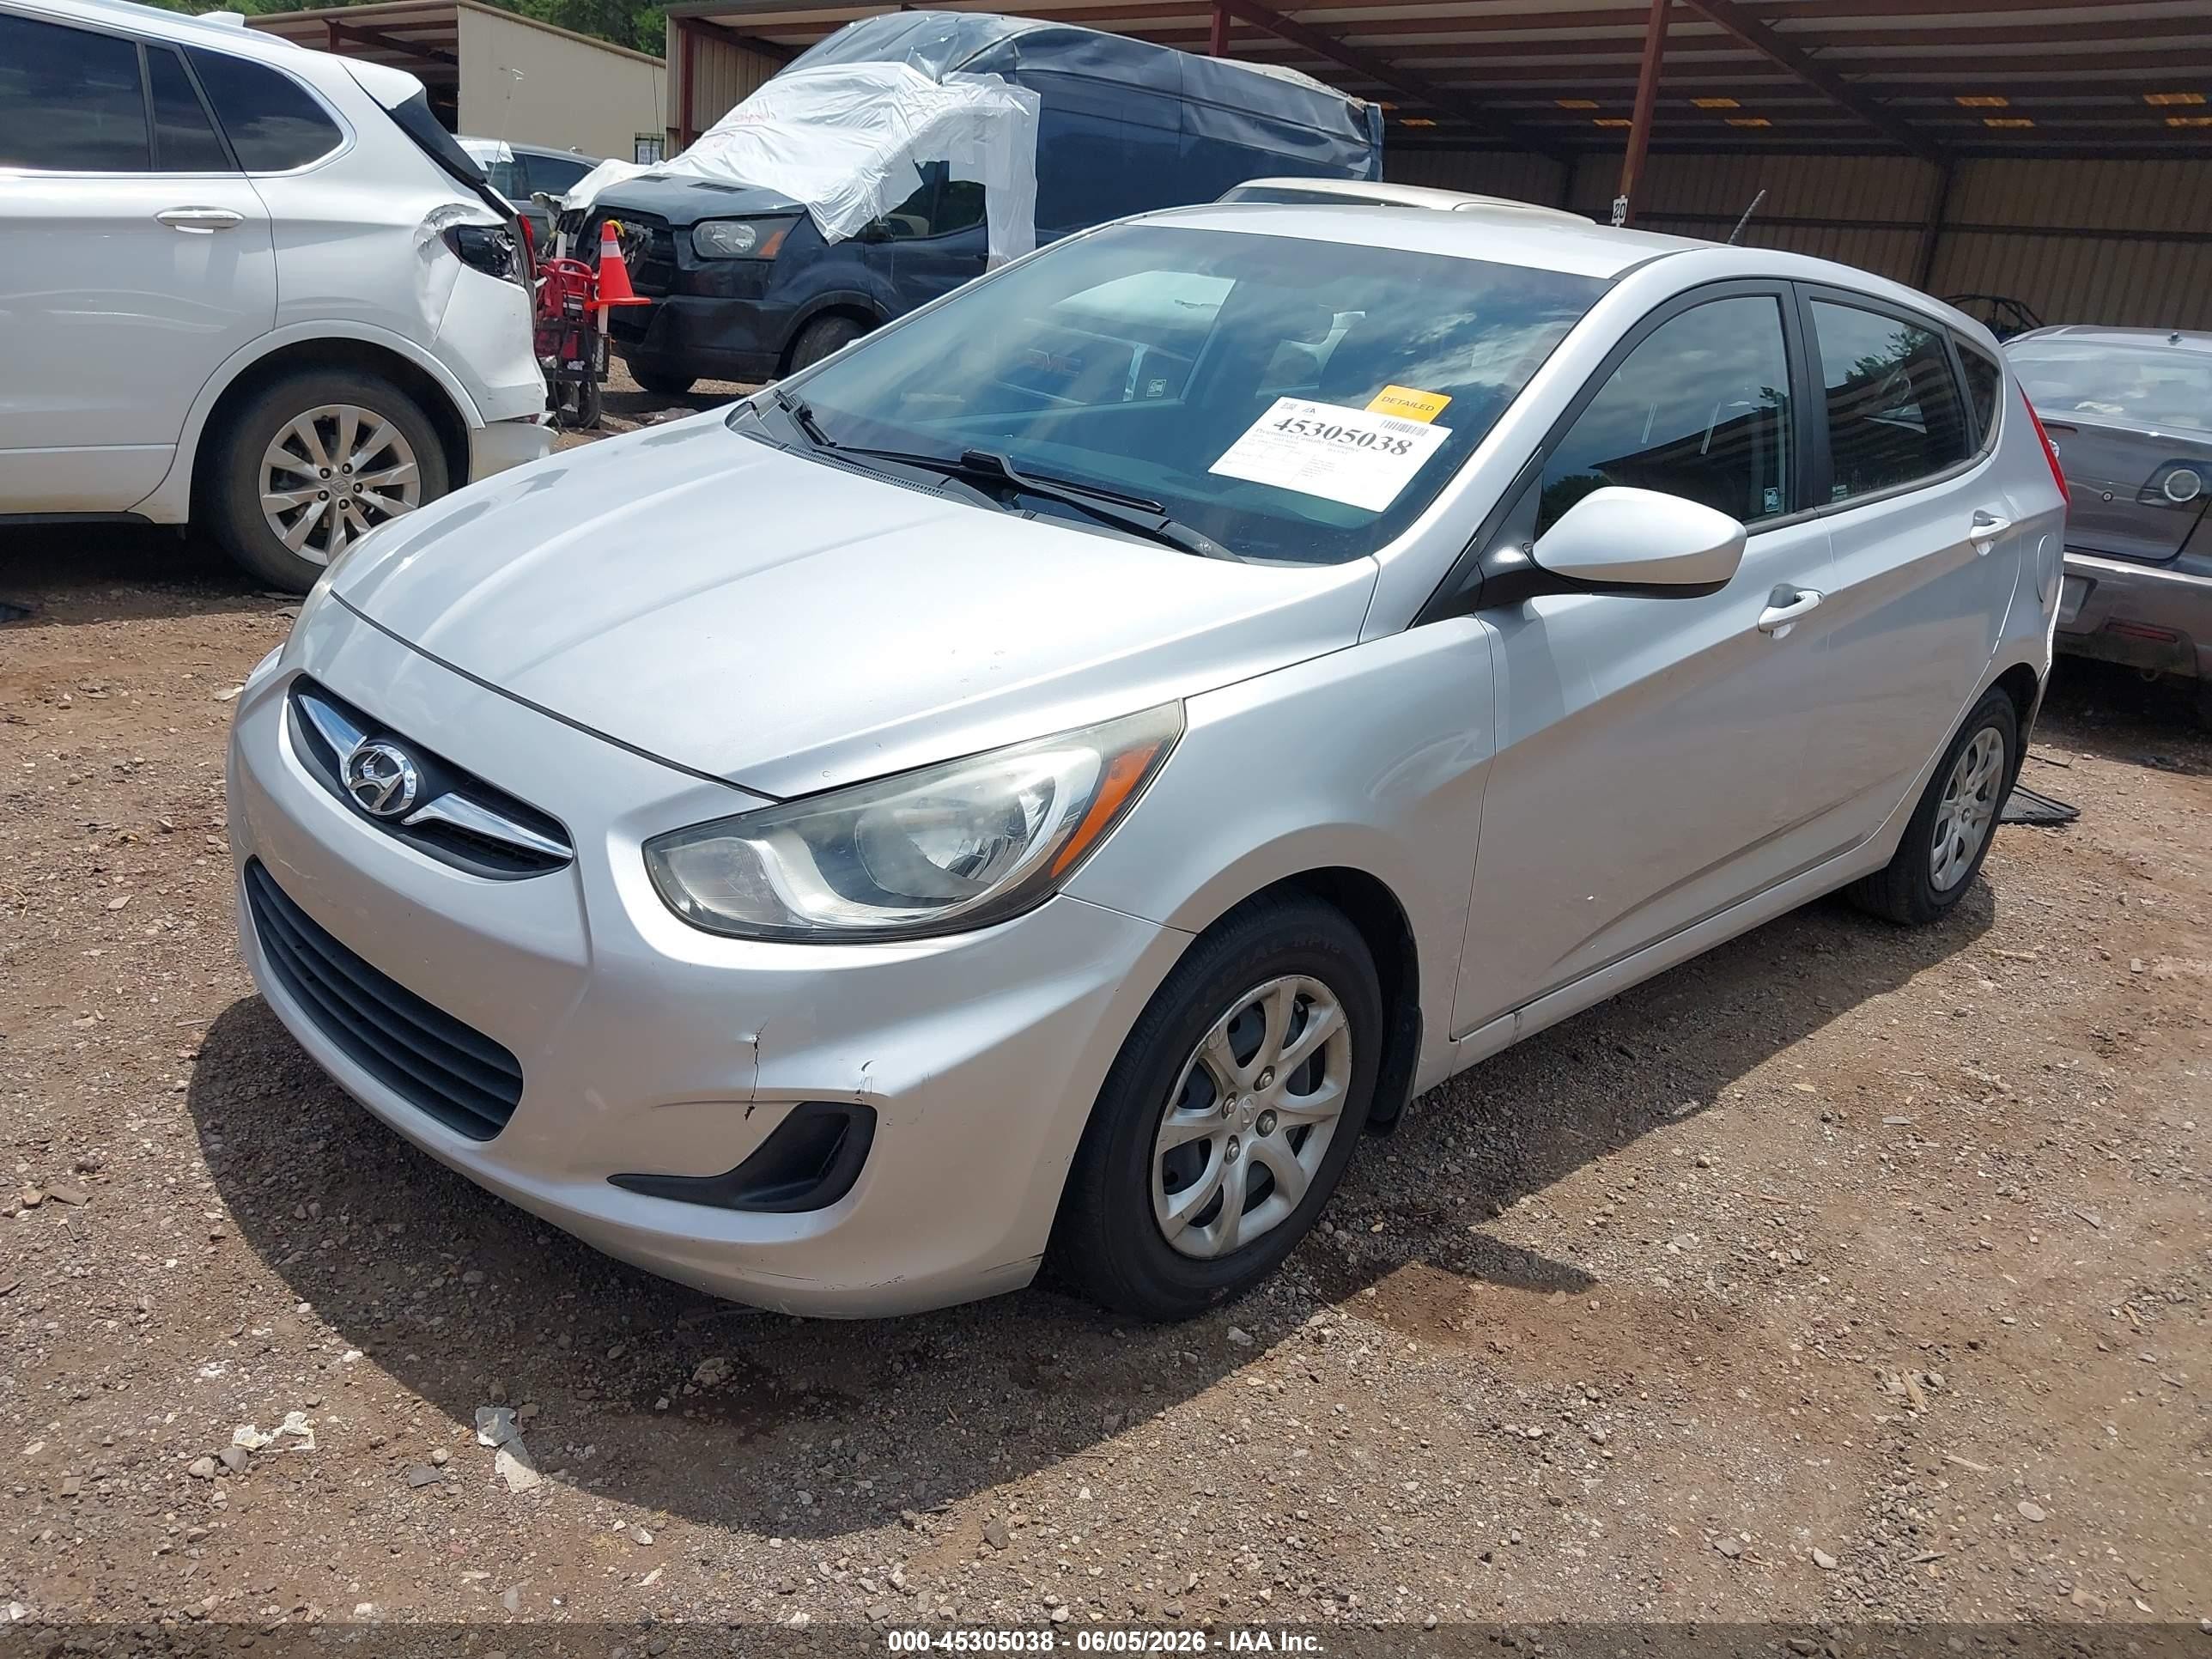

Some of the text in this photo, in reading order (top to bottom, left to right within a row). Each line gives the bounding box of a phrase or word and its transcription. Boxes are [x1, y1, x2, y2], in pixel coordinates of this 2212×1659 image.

[1613, 203, 1626, 219] 20
[1381, 396, 1435, 411] DETAILED
[1273, 417, 1413, 455] 45305038
